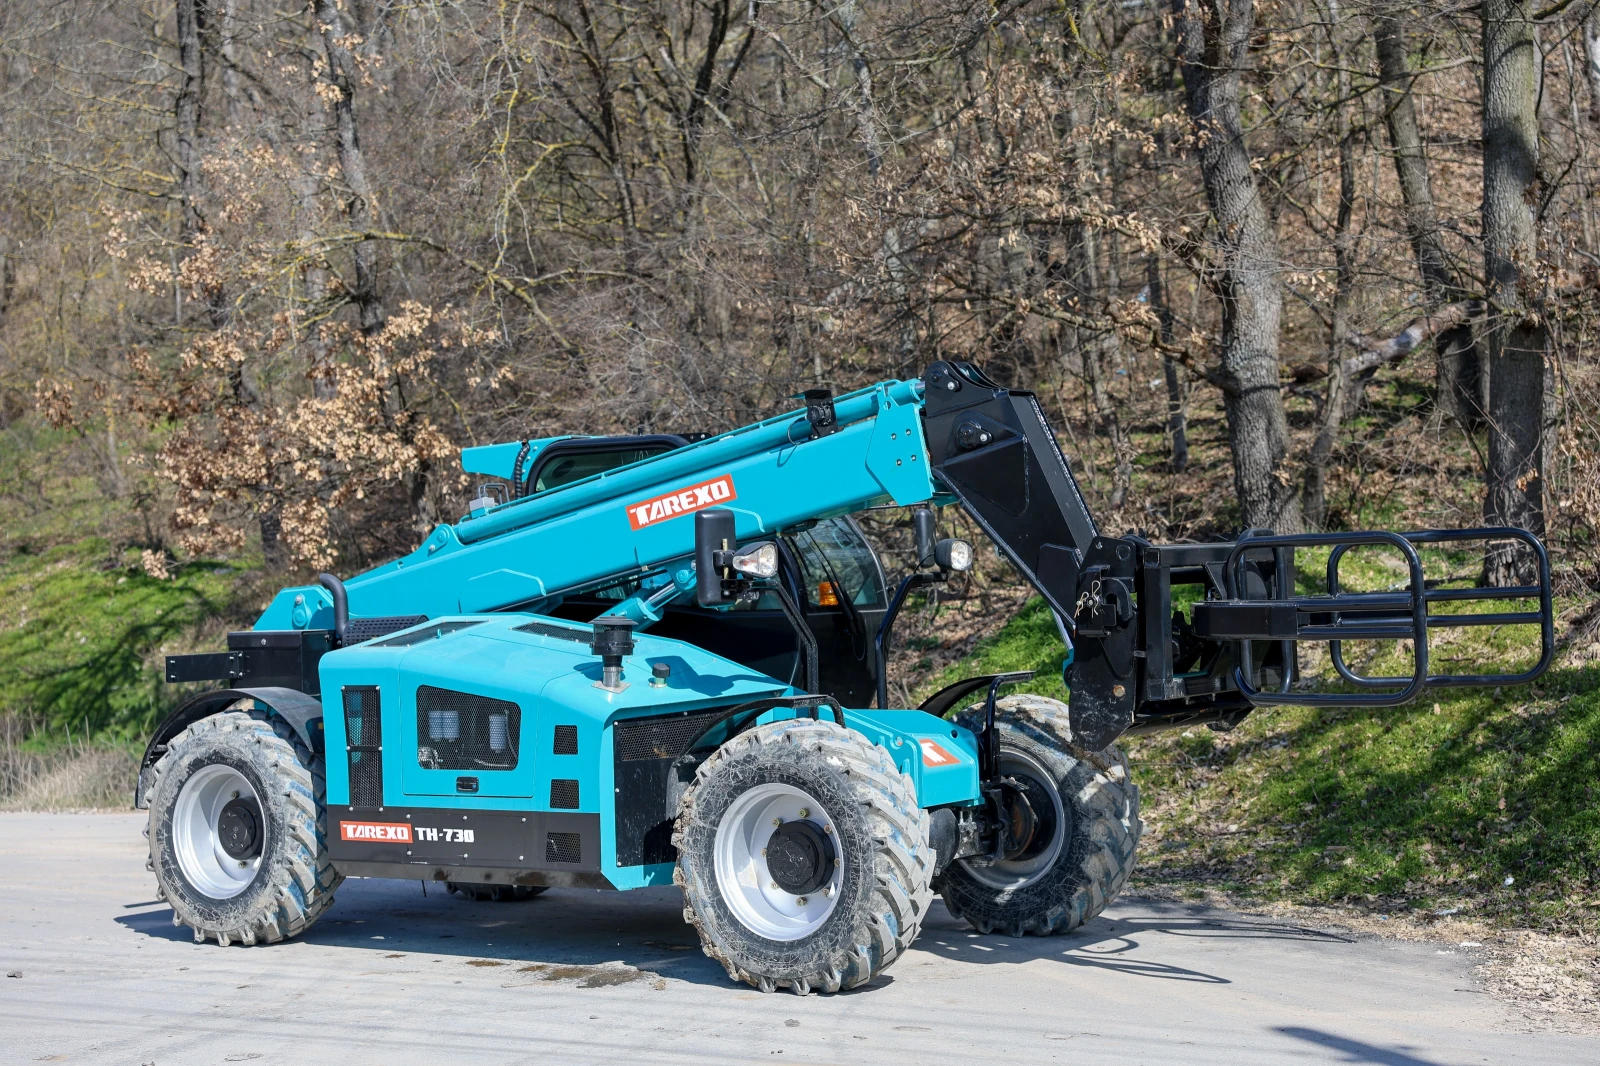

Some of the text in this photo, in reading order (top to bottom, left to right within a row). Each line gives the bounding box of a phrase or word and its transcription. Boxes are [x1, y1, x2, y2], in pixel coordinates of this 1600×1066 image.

[630, 480, 731, 526] TAREXO
[343, 824, 475, 843] TAREXO TH-730
